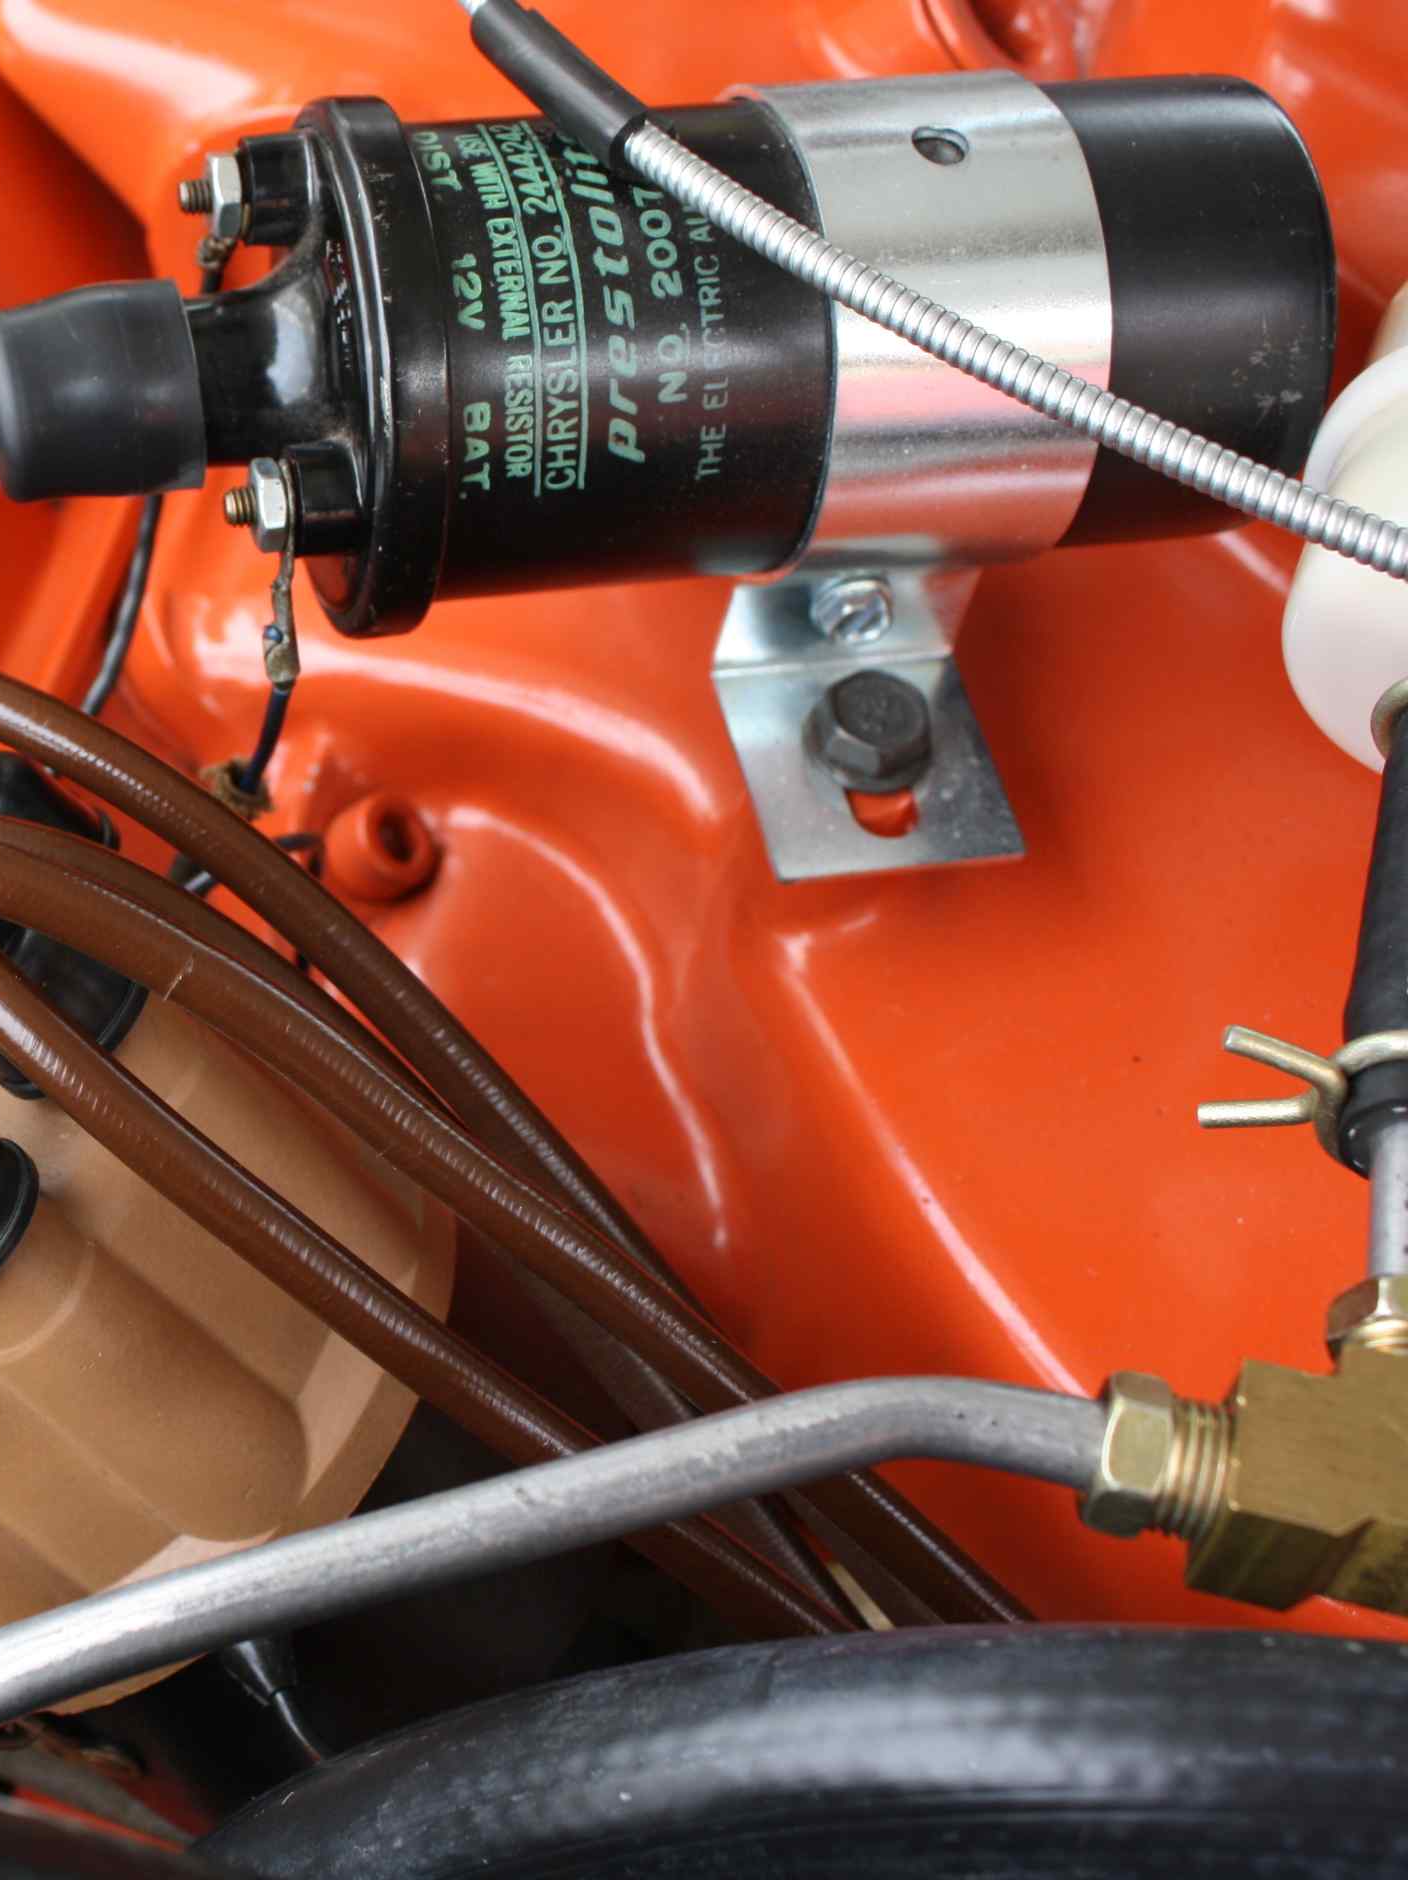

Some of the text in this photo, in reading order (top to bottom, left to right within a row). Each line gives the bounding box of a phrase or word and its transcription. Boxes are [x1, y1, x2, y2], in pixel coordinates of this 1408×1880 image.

[452, 253, 486, 331] 12V
[532, 225, 572, 286] NO.
[561, 133, 647, 464] prestolit
[454, 133, 535, 480] USE WITH EXTERNAL RESISTOR
[693, 253, 730, 411] ELECTRIC
[542, 299, 580, 491] CHRYSLER
[657, 322, 689, 403] NO.
[458, 402, 491, 499] BAT.
[695, 424, 727, 481] THE
